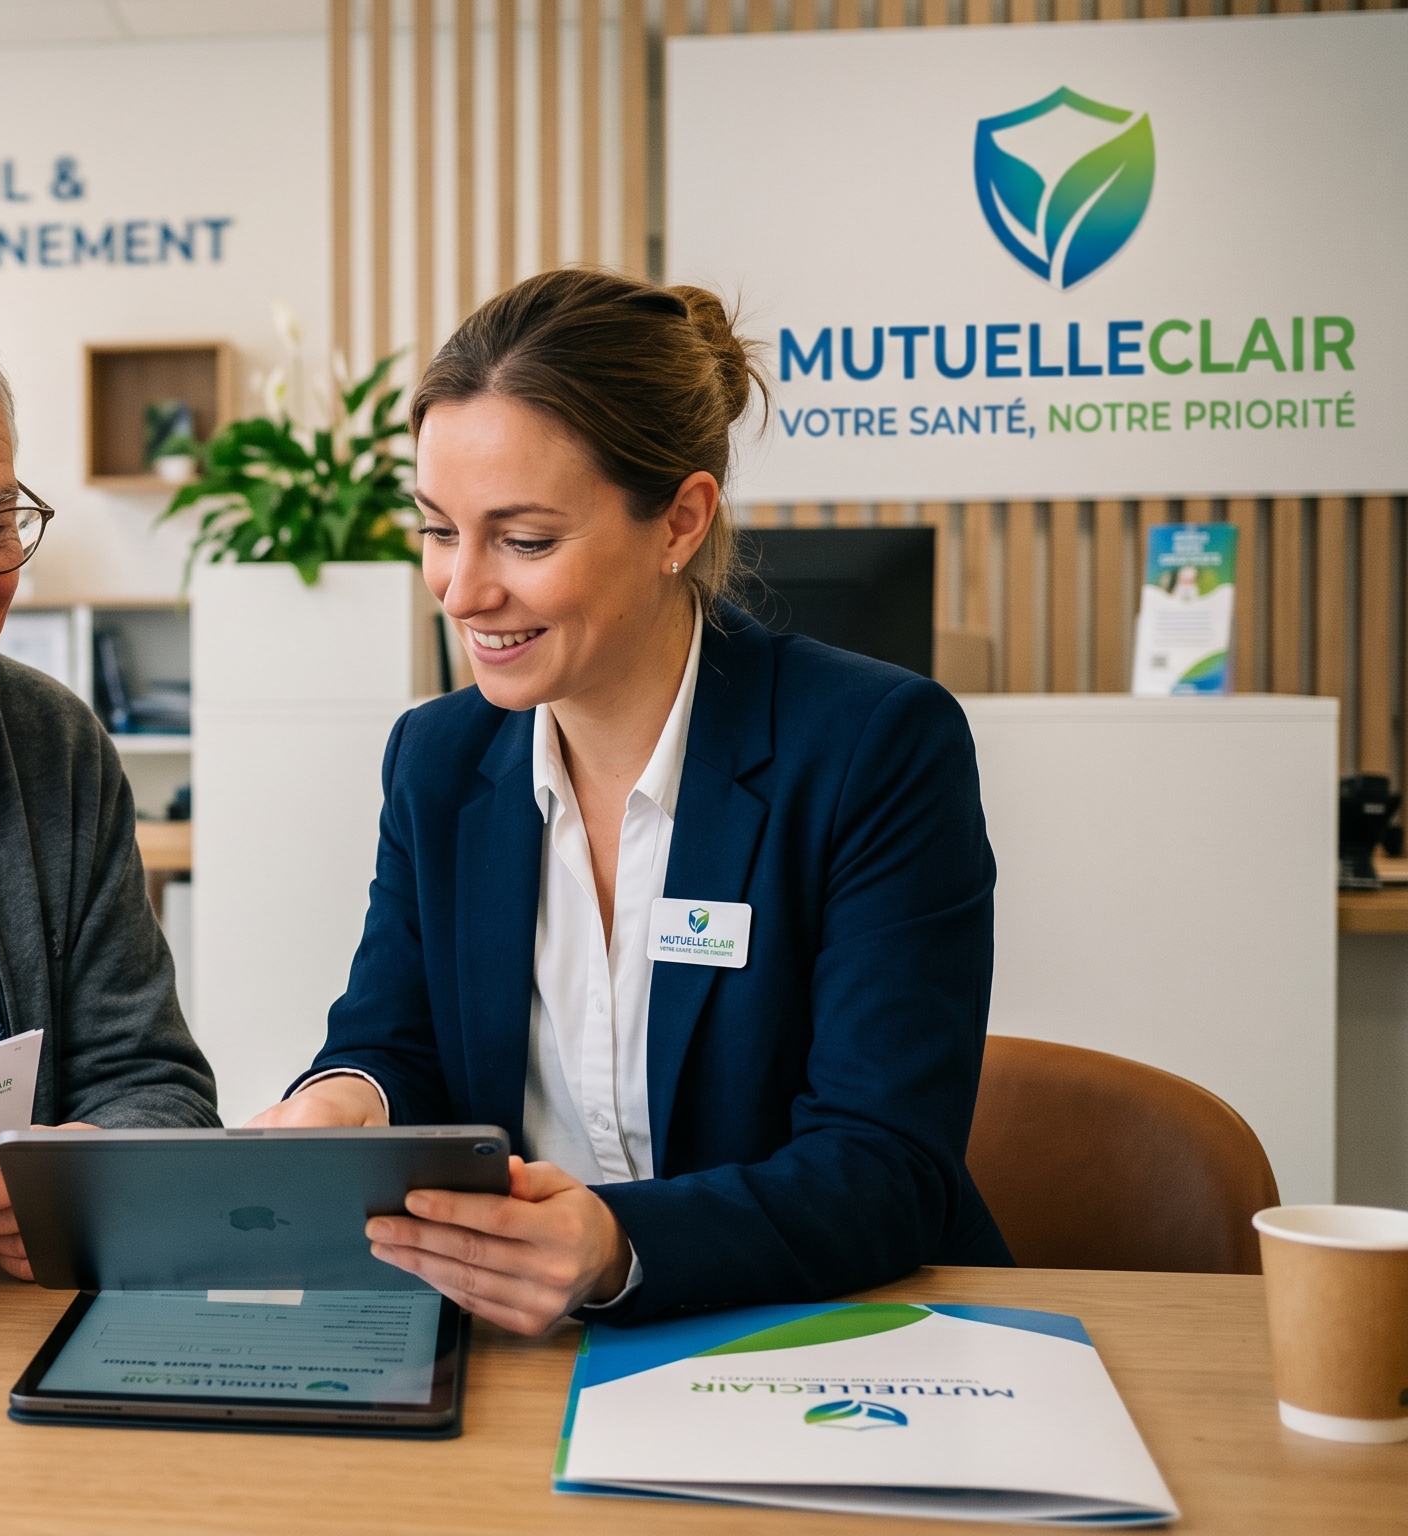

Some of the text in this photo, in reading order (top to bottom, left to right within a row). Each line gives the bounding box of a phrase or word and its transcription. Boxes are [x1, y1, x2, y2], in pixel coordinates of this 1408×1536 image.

[51, 156, 85, 201] &
[779, 316, 1356, 382] MUTUELLECLAIR
[779, 391, 1355, 440] VOTRE SANTÉ, NOTRE PRIORITÉ
[660, 935, 734, 949] MUTUELLECLAIR
[691, 1381, 1015, 1398] MUTUELLECLAIR
